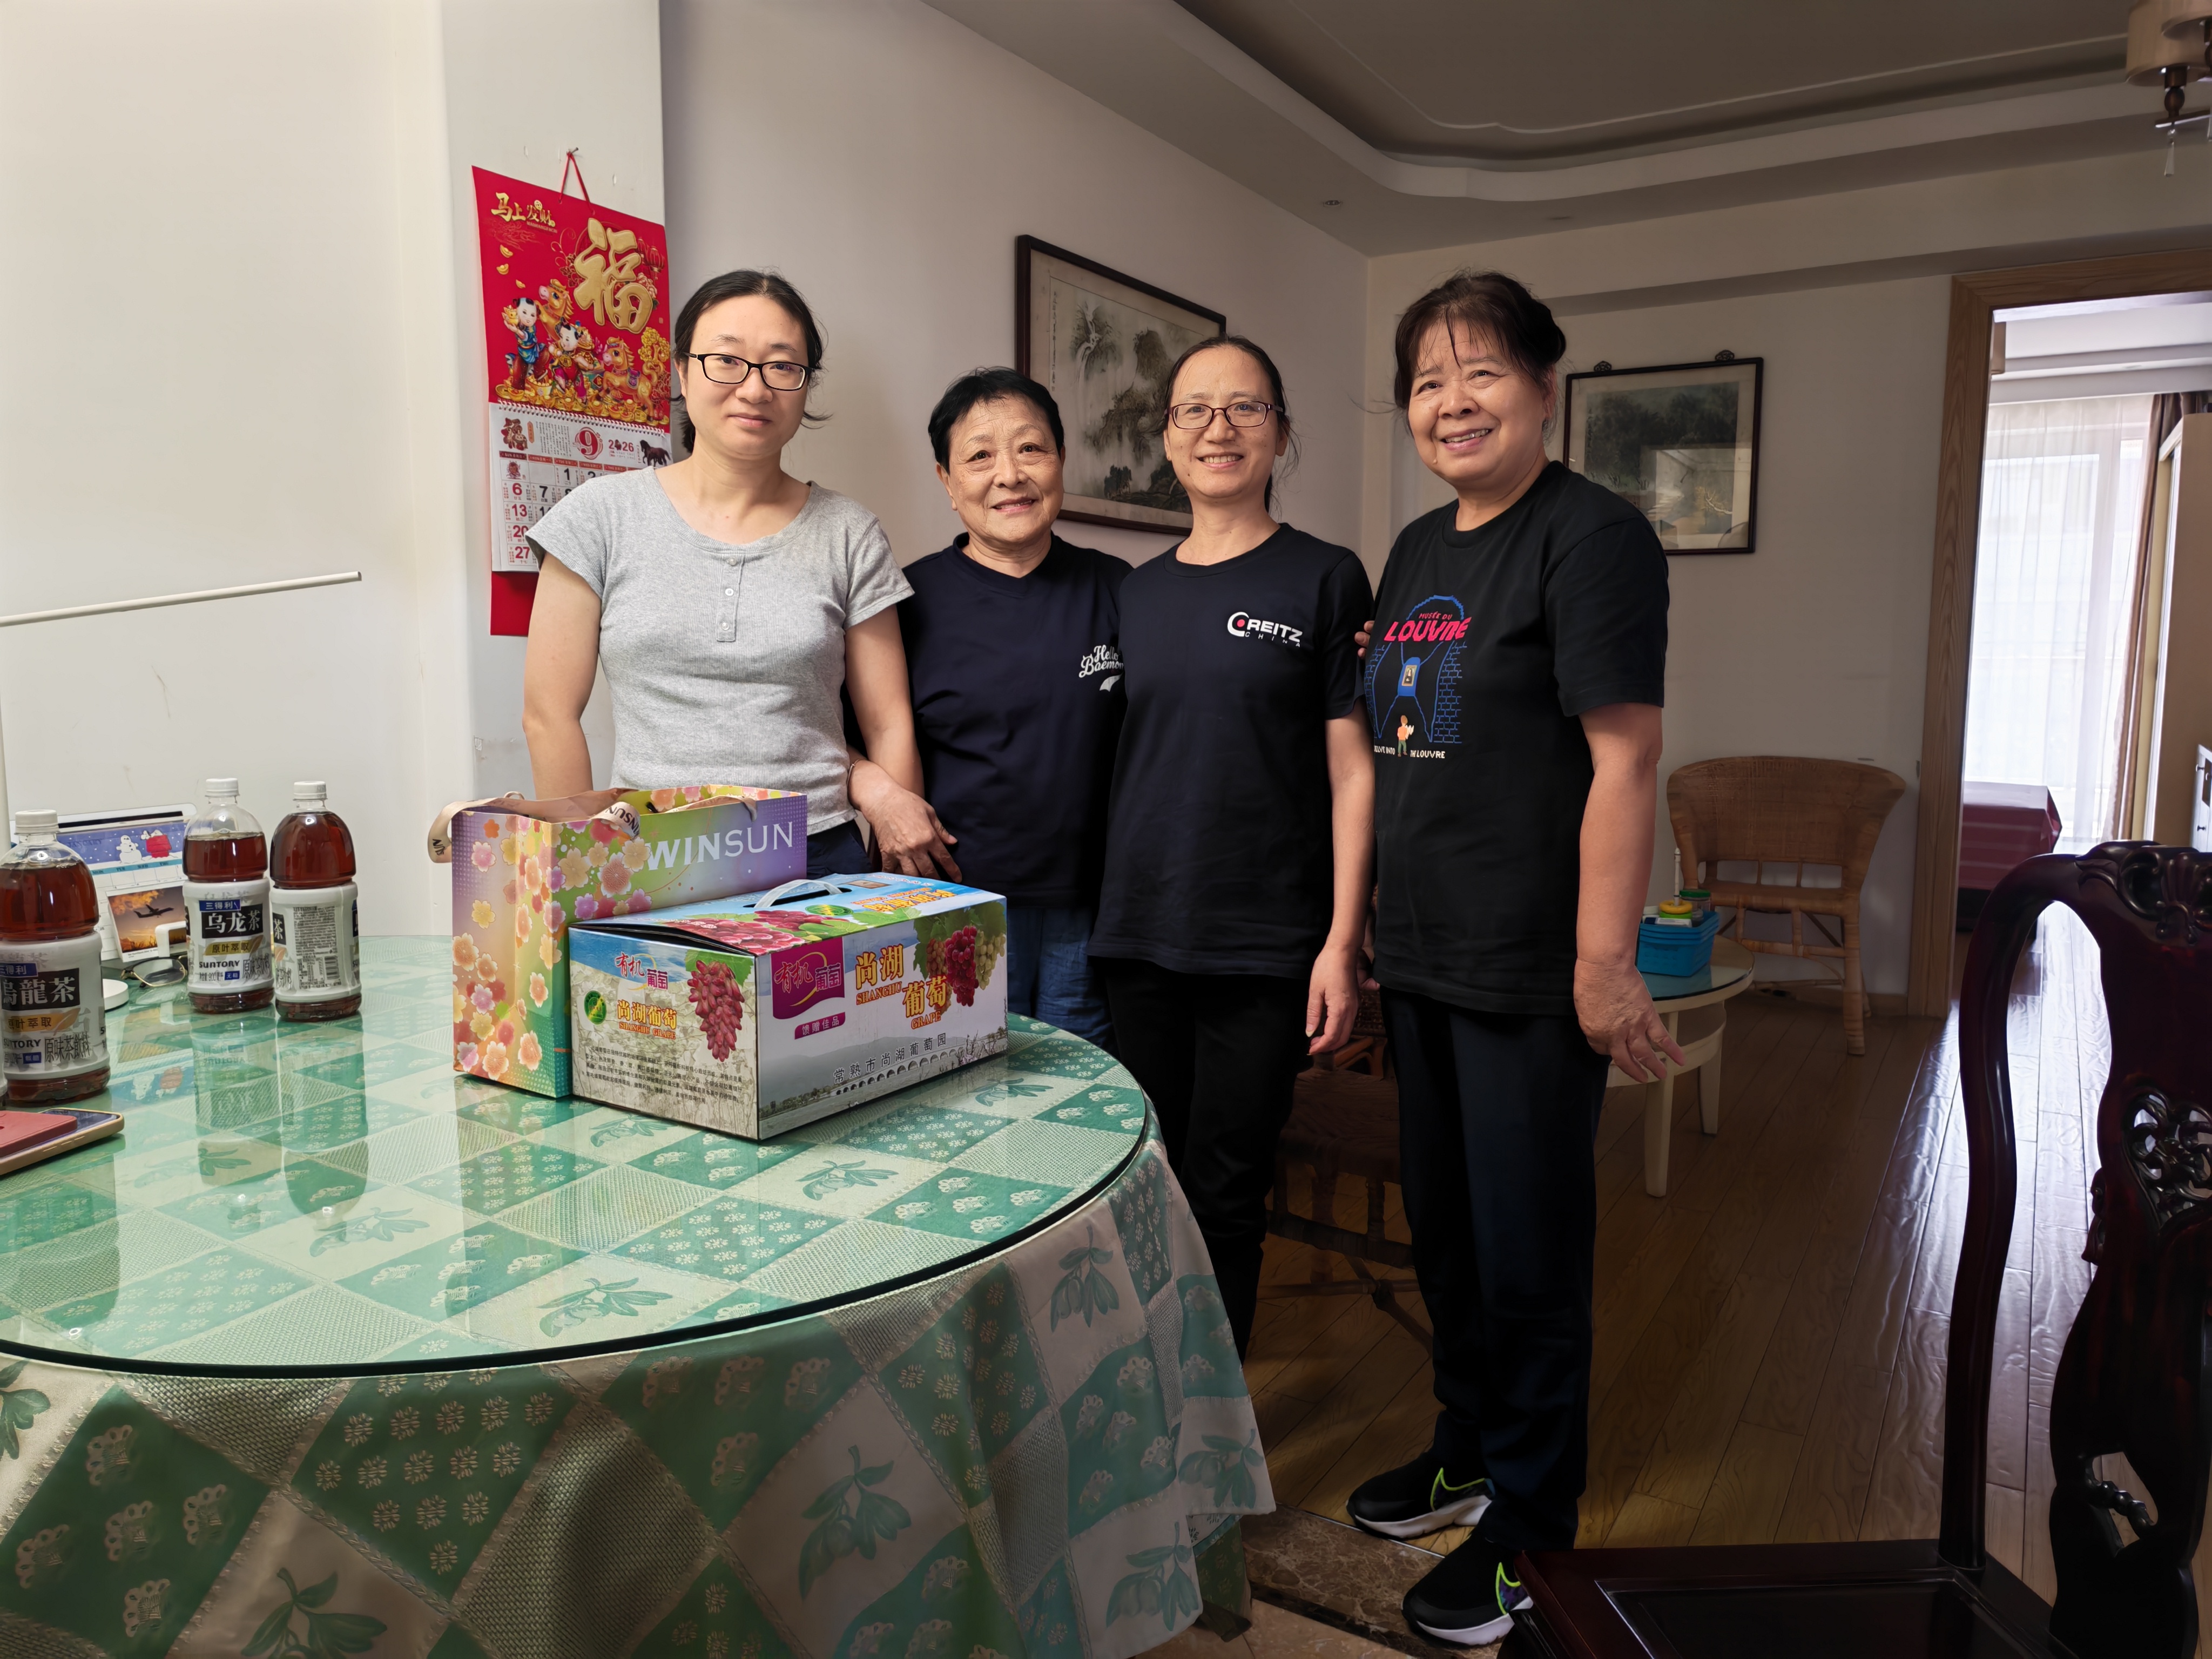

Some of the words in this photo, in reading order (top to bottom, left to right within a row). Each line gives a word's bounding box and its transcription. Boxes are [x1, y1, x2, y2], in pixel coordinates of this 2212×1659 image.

[573, 217, 653, 334] 福
[579, 430, 598, 456] 9
[564, 468, 570, 481] 1
[512, 482, 522, 495] 6
[539, 485, 548, 497] 7
[512, 503, 527, 517] 13
[515, 546, 530, 559] 27
[1419, 611, 1441, 619] MUSÉE
[1384, 617, 1472, 642] LOUVRE
[1245, 631, 1300, 648] CHINA
[1094, 644, 1118, 663] Hello
[1386, 746, 1395, 755] INTO
[1416, 750, 1445, 759] LOUVRE
[647, 821, 793, 871] WINSUN
[206, 901, 233, 909] 三得利
[205, 909, 261, 934] 乌龙茶
[212, 942, 249, 953] 原叶萃取
[615, 952, 645, 978] 有机
[647, 968, 669, 990] 葡萄
[855, 943, 904, 990] 尚湖
[773, 961, 813, 994] 有机
[814, 963, 841, 992] 葡萄
[857, 982, 902, 1005] SHANGHU
[902, 975, 948, 1018] 葡萄
[617, 1000, 677, 1030] 尚湖葡萄
[911, 1011, 942, 1029] GRAPE
[619, 1022, 650, 1035] SHANGHU
[652, 1028, 676, 1040] GRAPE
[802, 1016, 840, 1035] 馈赠佳品
[833, 1033, 946, 1084] 常熟市尚湖葡萄园
